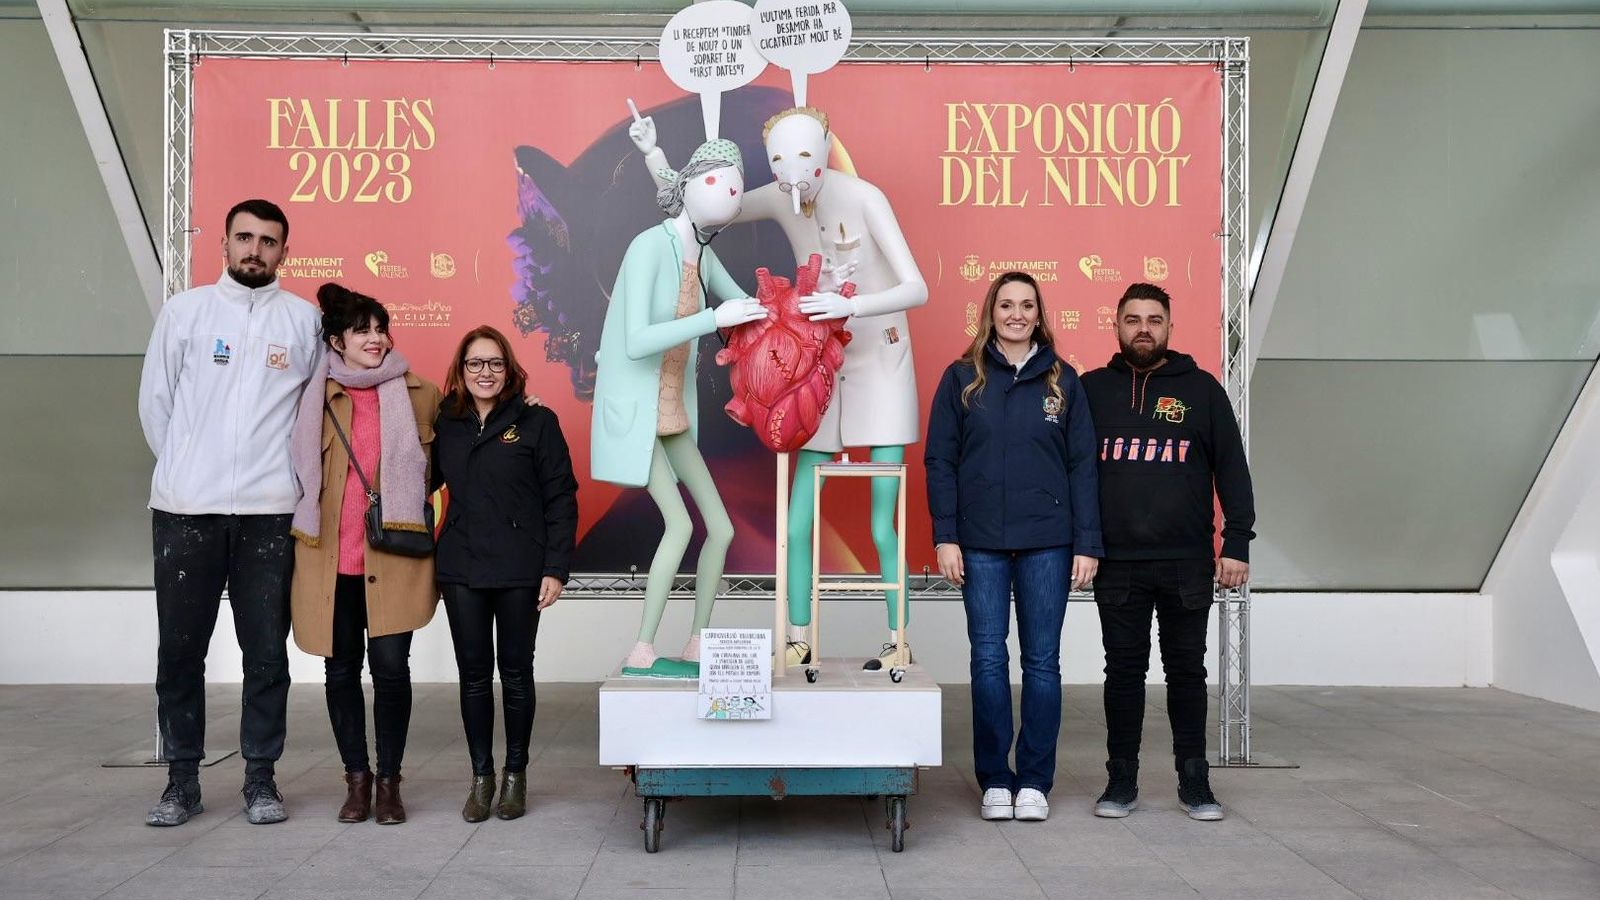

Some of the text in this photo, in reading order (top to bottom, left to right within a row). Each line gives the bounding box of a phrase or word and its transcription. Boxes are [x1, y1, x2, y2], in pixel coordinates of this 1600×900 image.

[795, 5, 821, 18] FERIDA
[823, 2, 837, 15] PER
[776, 17, 824, 34] DESAMOR HA
[673, 29, 680, 41] LI
[682, 27, 719, 40] RECEPTEM
[760, 33, 806, 50] CICATRITZAT
[810, 30, 829, 43] MOLT
[686, 39, 743, 53] DE NOU? O UN
[693, 52, 737, 65] SOPARET EN
[689, 65, 713, 78] "FIRST
[266, 96, 437, 152] FALLES
[943, 97, 1182, 156] EXPOSICIÓ
[288, 151, 413, 204] 2023
[938, 152, 1192, 208] DEL NINOT
[283, 257, 344, 267] JUNTAMENT
[989, 261, 1058, 270] AJUNTAMENT
[404, 313, 451, 321] CIUTAT
